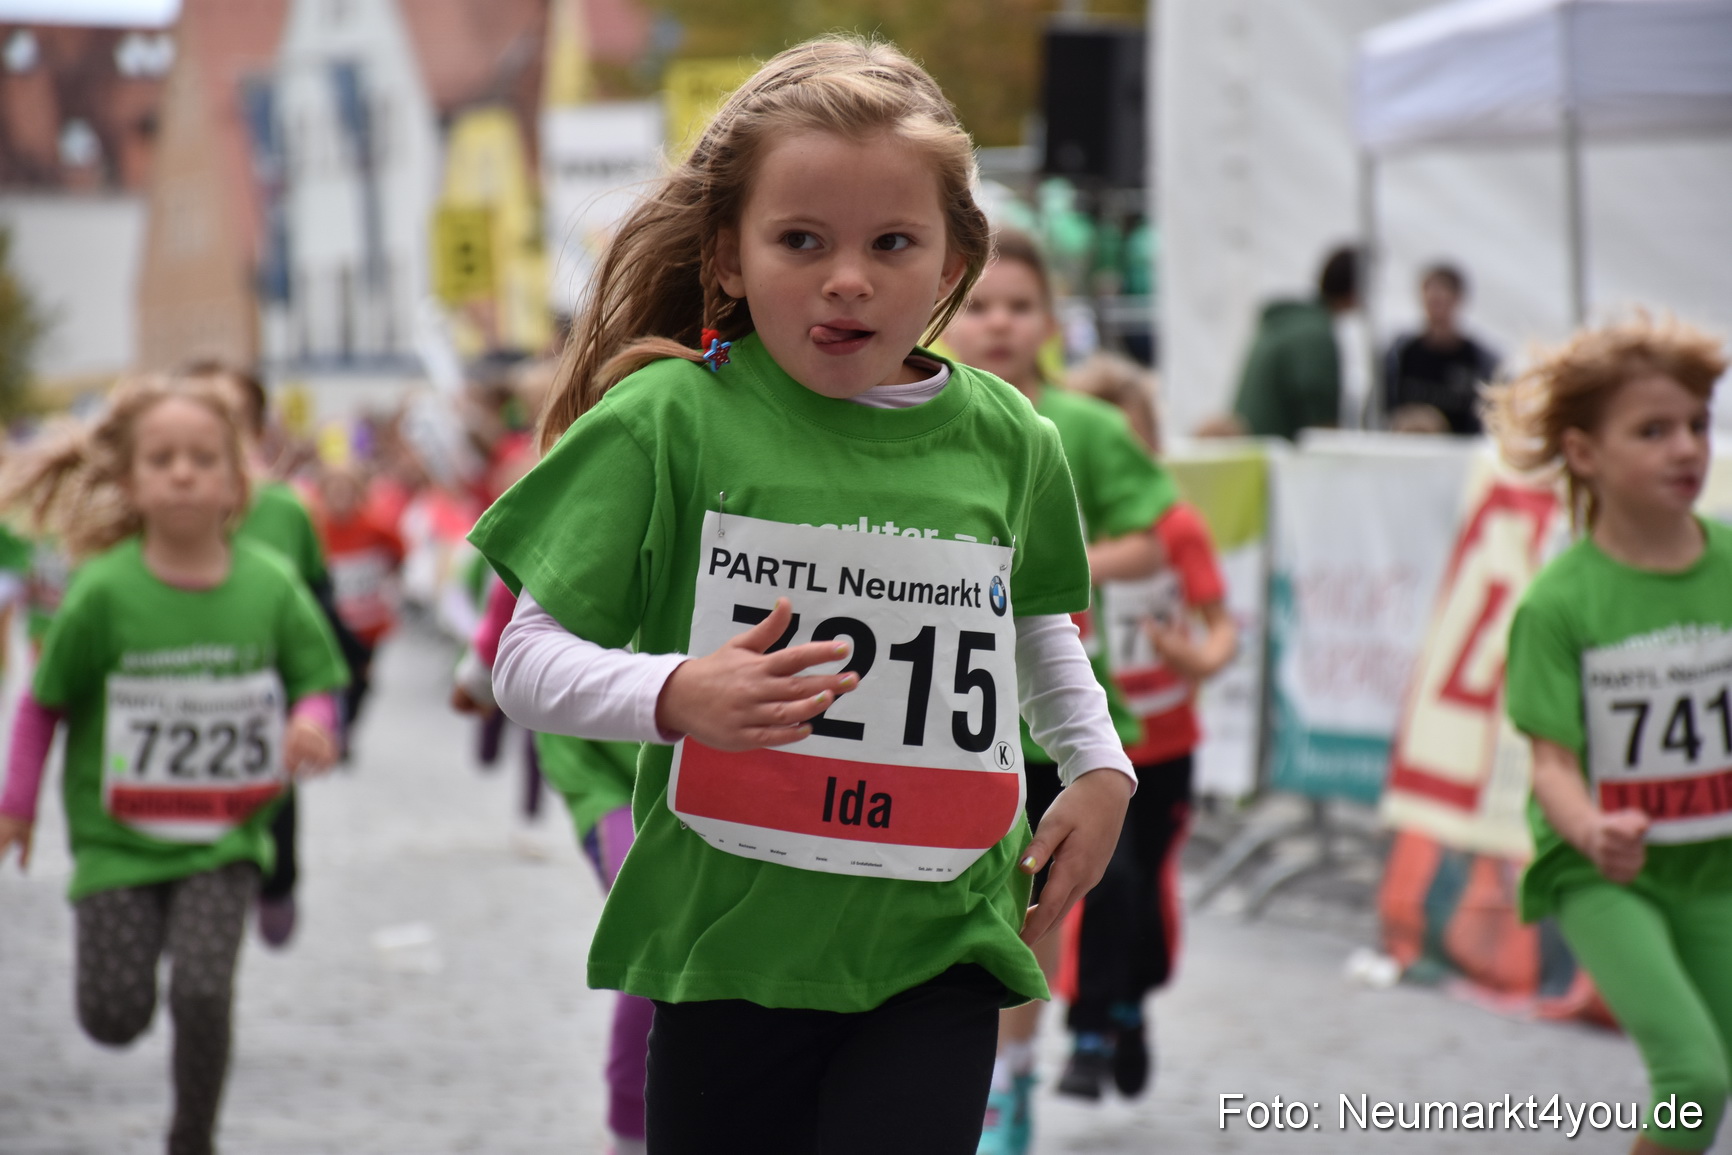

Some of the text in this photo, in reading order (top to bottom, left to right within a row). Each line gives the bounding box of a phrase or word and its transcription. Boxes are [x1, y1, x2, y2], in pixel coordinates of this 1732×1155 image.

[708, 547, 982, 609] PARTL Neumarkt
[131, 717, 271, 778] 7225
[1610, 687, 1732, 769] 741
[822, 776, 893, 829] Ida
